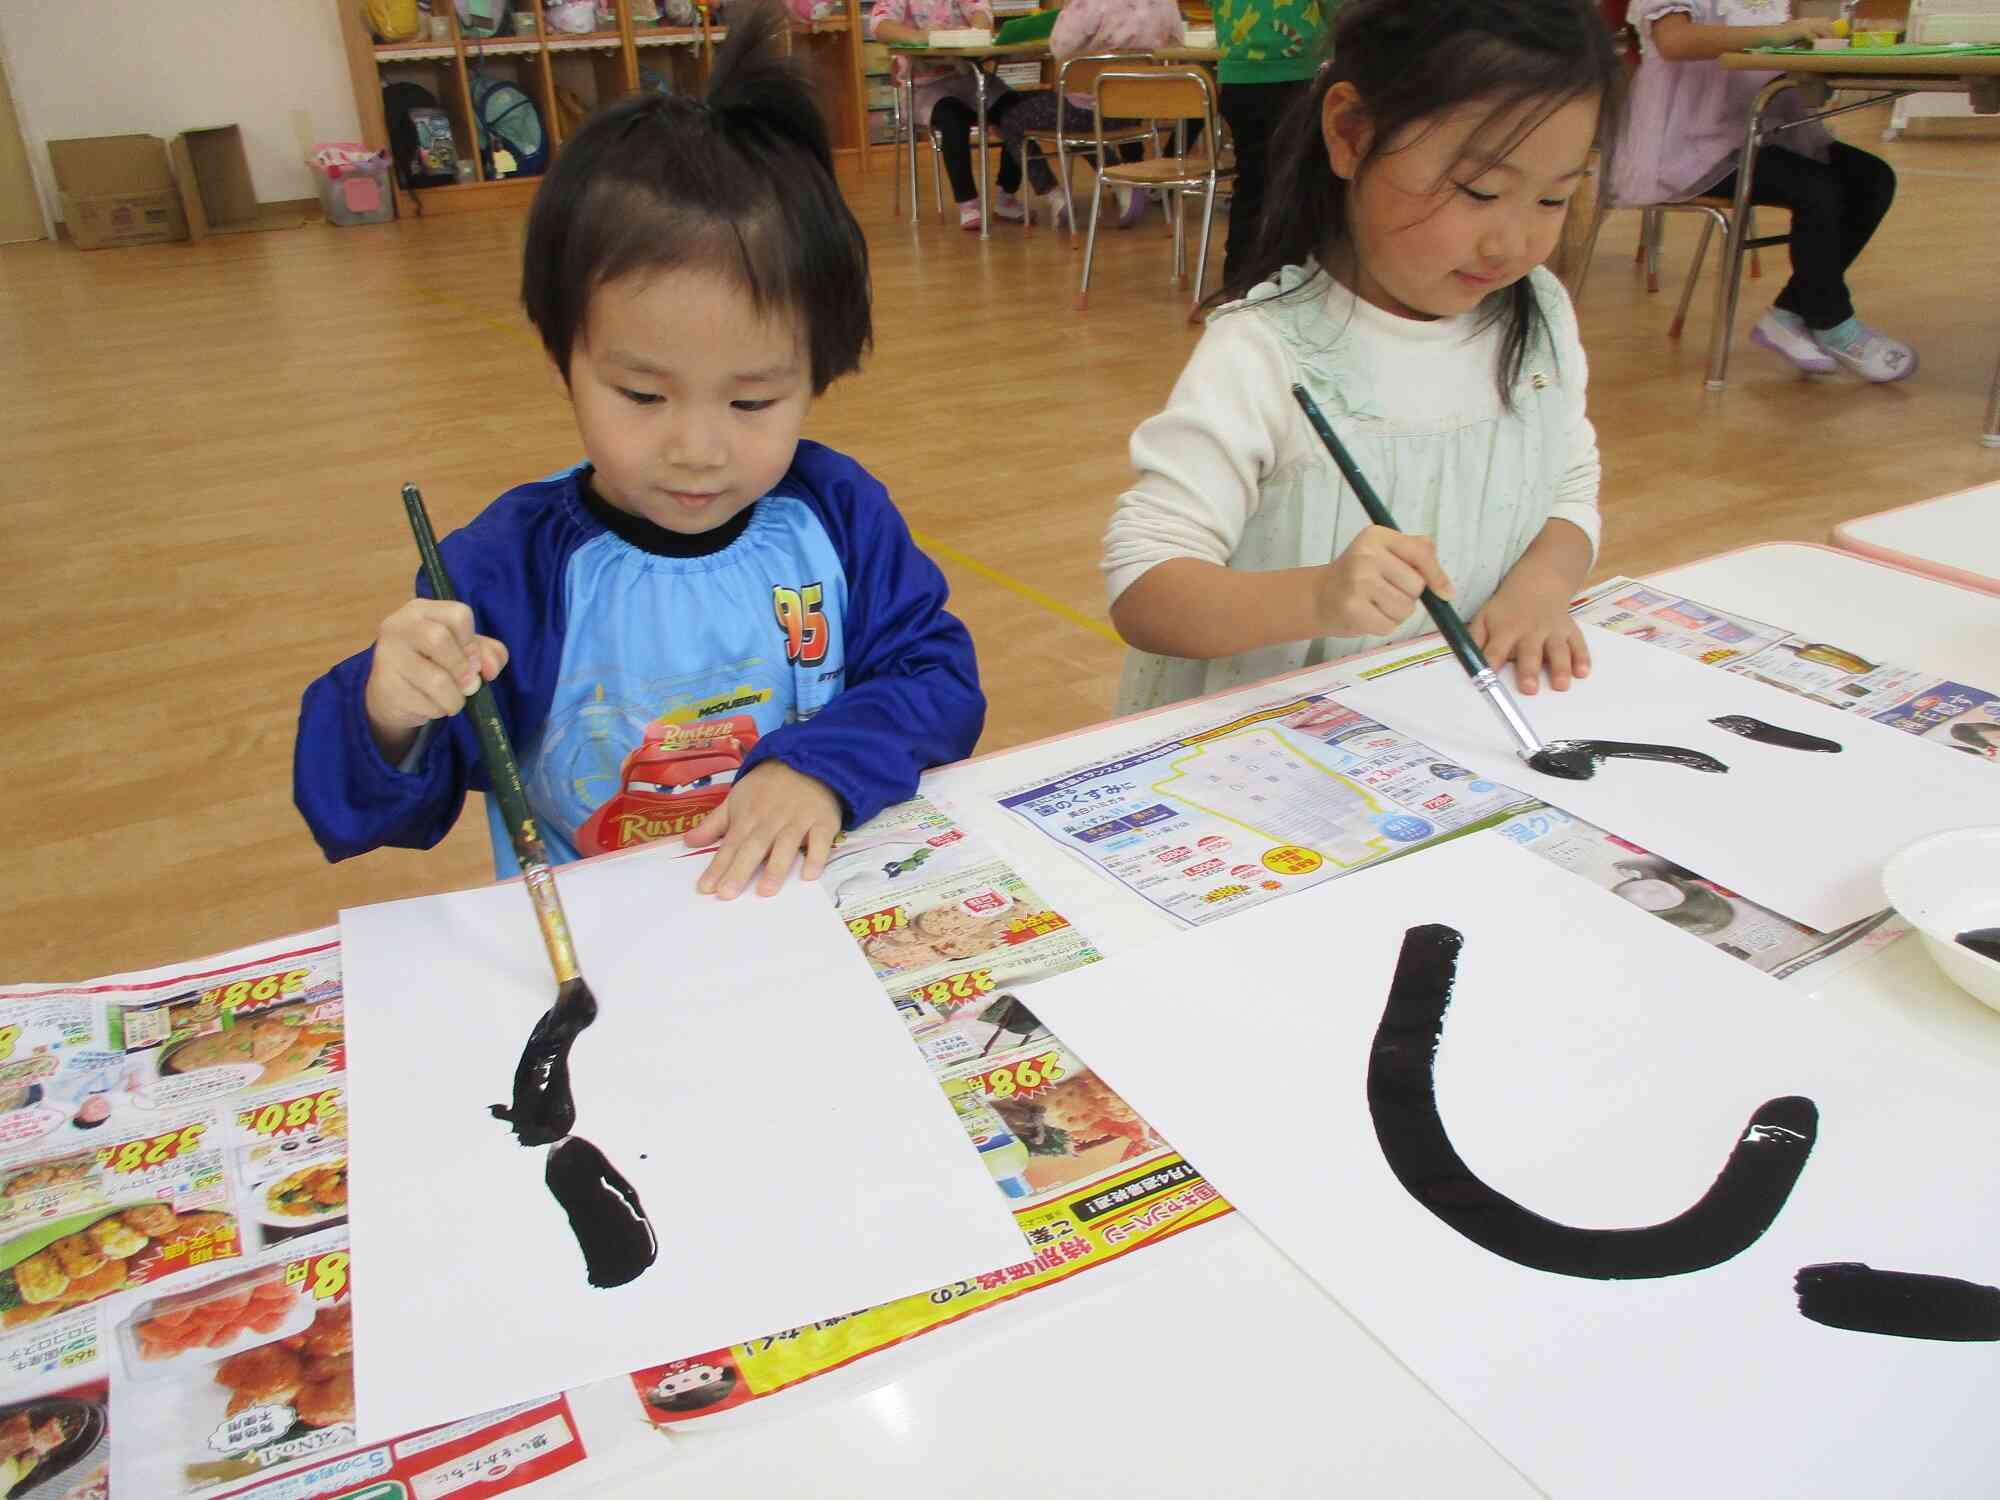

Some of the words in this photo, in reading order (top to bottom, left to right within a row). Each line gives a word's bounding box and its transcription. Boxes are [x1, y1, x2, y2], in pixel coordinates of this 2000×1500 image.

[772, 582, 830, 668] 95
[848, 905, 910, 938] 148
[969, 1053, 1065, 1099] 298円
[1027, 1219, 1073, 1247] ご案
[1103, 1182, 1222, 1245] 国キャンペーン
